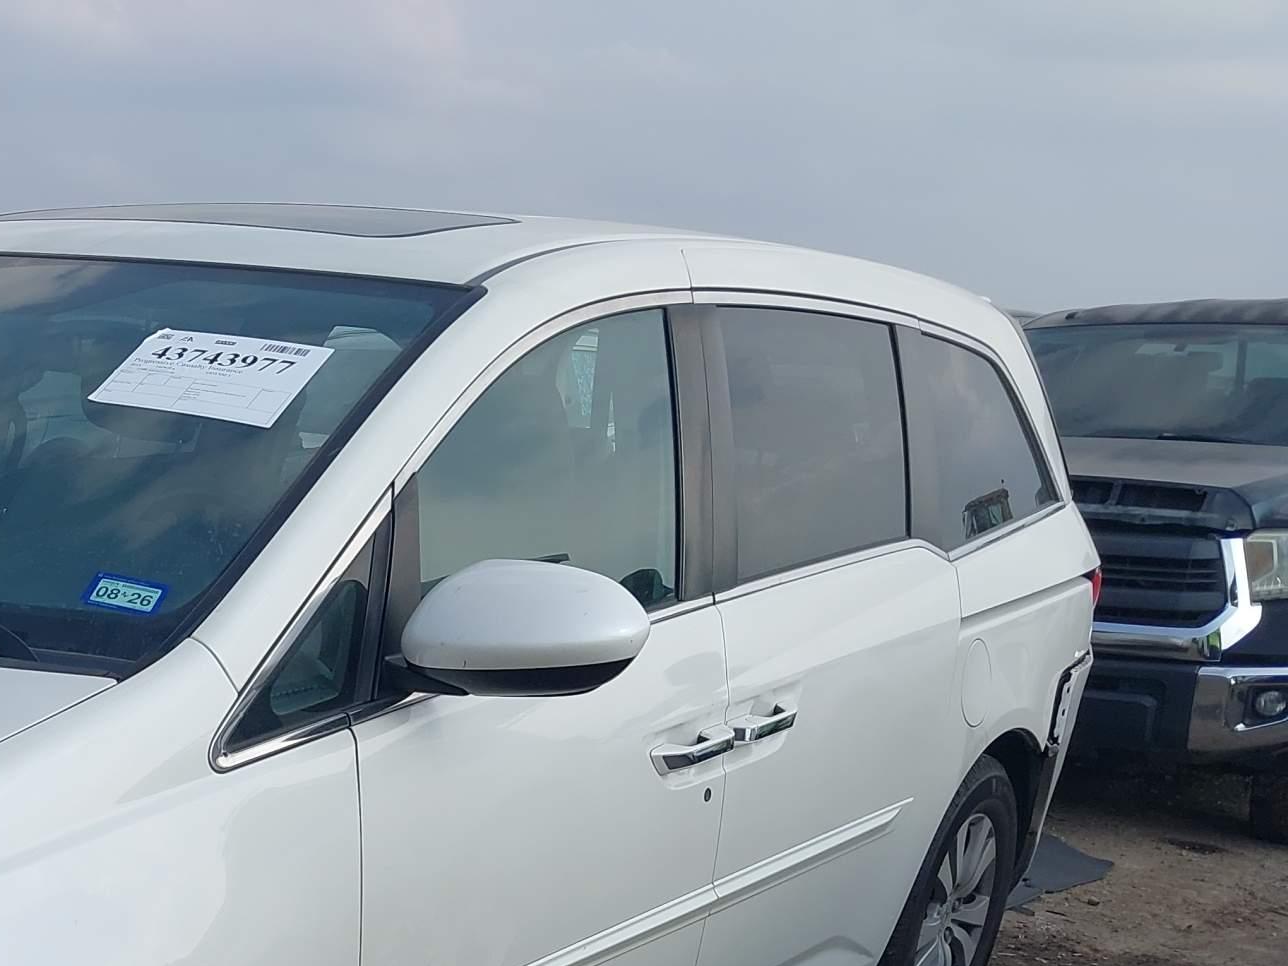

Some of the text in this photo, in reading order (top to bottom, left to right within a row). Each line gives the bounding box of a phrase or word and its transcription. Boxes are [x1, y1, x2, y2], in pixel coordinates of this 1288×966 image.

[151, 346, 297, 375] 43743977
[95, 585, 121, 600] 08
[127, 592, 154, 607] 26
